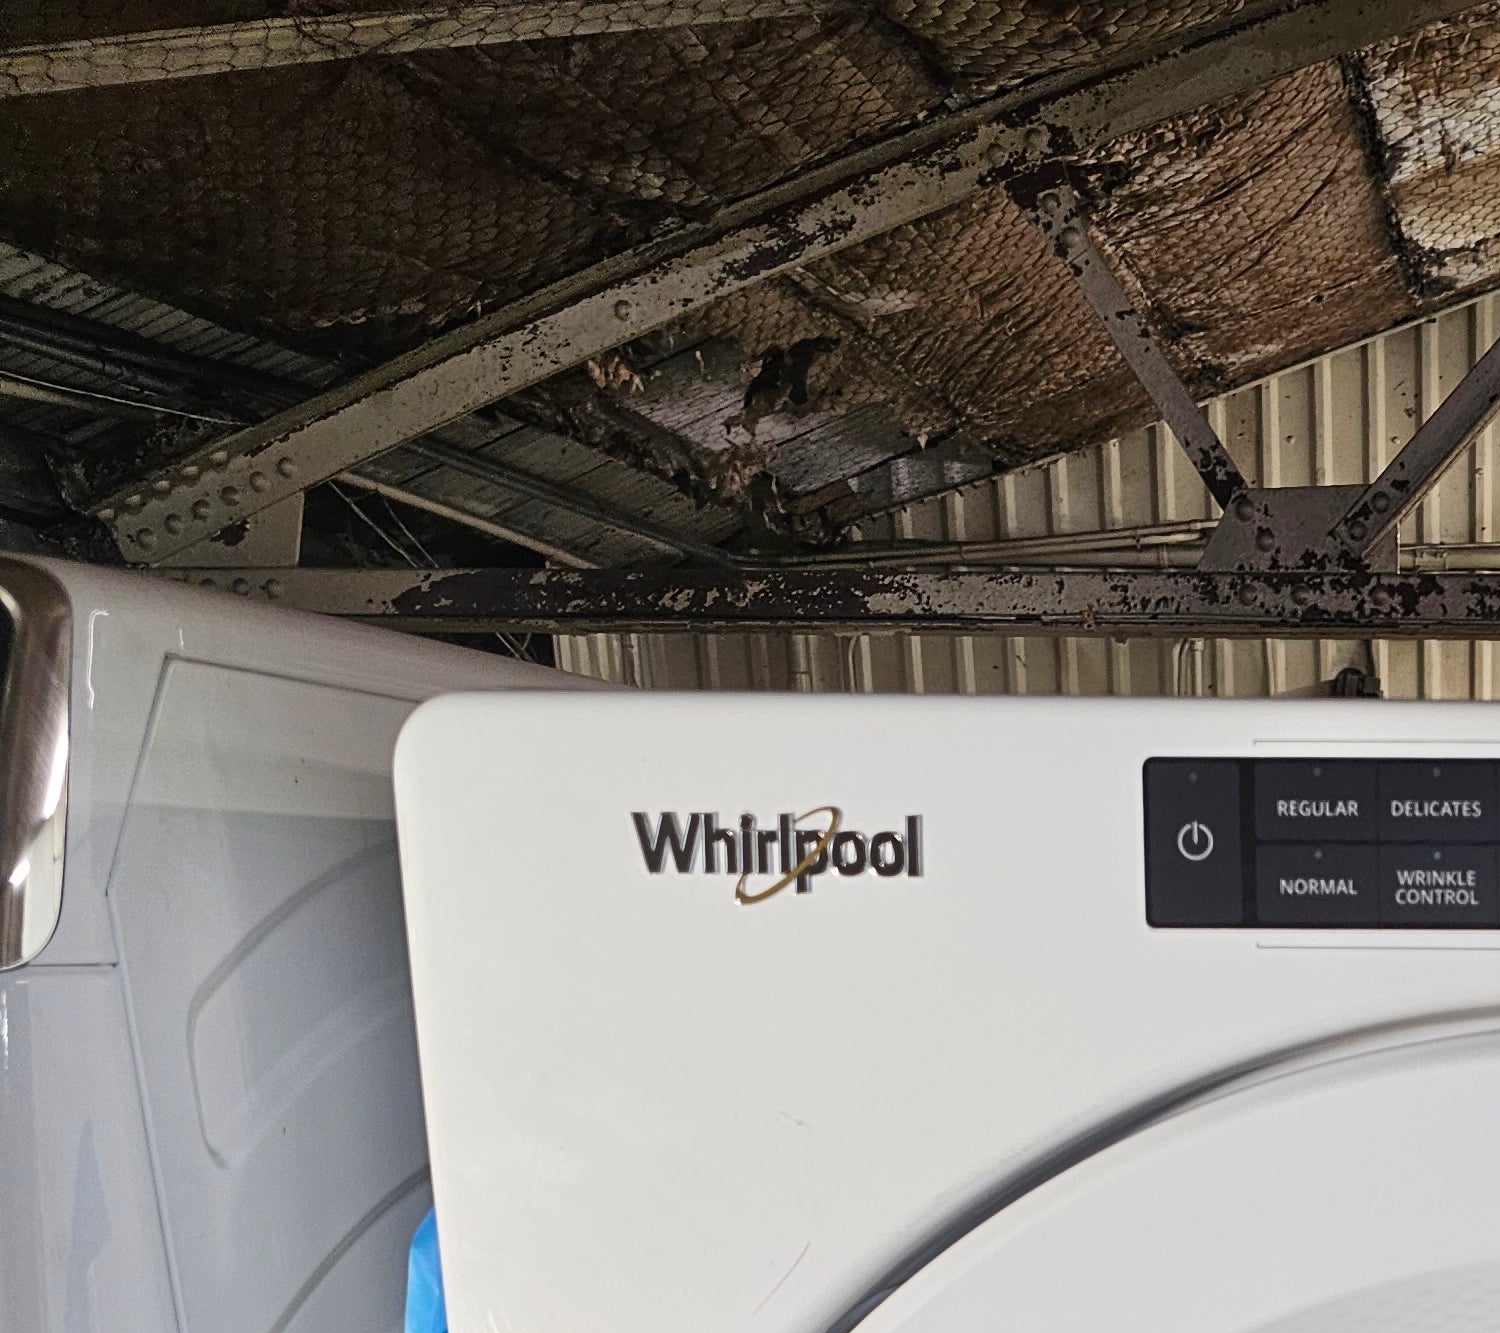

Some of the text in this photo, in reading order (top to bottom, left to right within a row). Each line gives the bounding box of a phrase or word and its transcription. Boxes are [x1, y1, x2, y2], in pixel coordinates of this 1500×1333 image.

[1277, 800, 1358, 816] REGULAR
[1391, 800, 1481, 817] DELICATES
[630, 811, 923, 894] Whirlpool
[1397, 870, 1475, 886] WRINKLE
[1280, 878, 1357, 895] NORMAL
[1395, 889, 1479, 905] CONTROL
